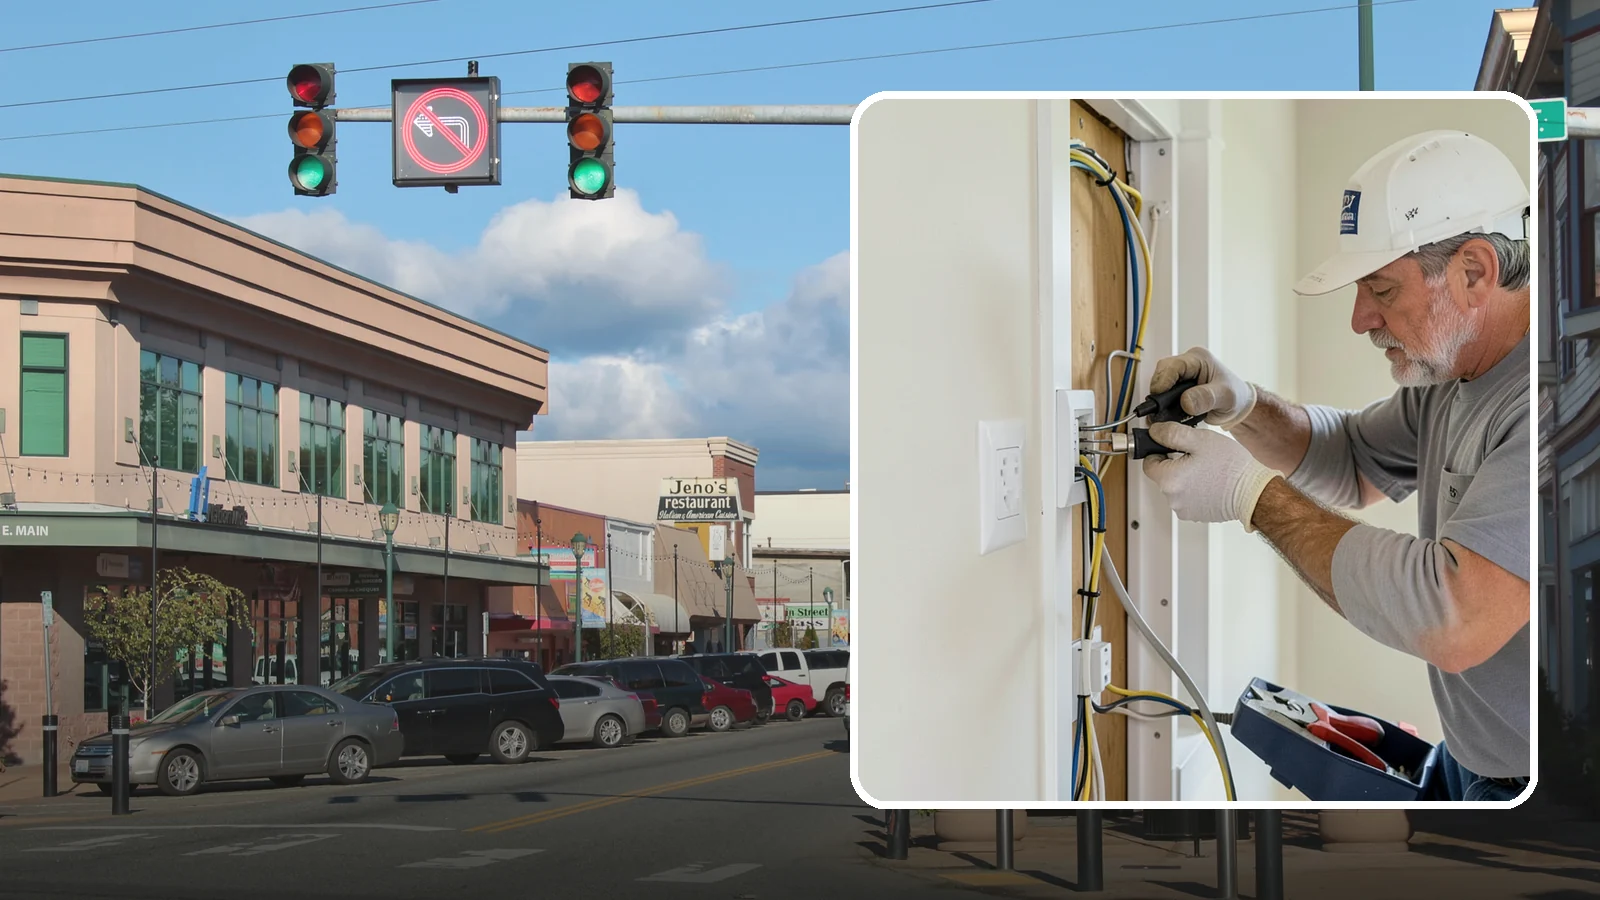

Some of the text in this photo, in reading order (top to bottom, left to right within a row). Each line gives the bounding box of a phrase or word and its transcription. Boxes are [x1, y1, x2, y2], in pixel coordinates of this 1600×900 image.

[669, 480, 728, 495] Jeno's
[665, 496, 731, 509] restaurant
[686, 509, 715, 520] American
[715, 509, 738, 520] Cuisine
[2, 525, 49, 536] E. MAIN
[797, 607, 828, 617] Street
